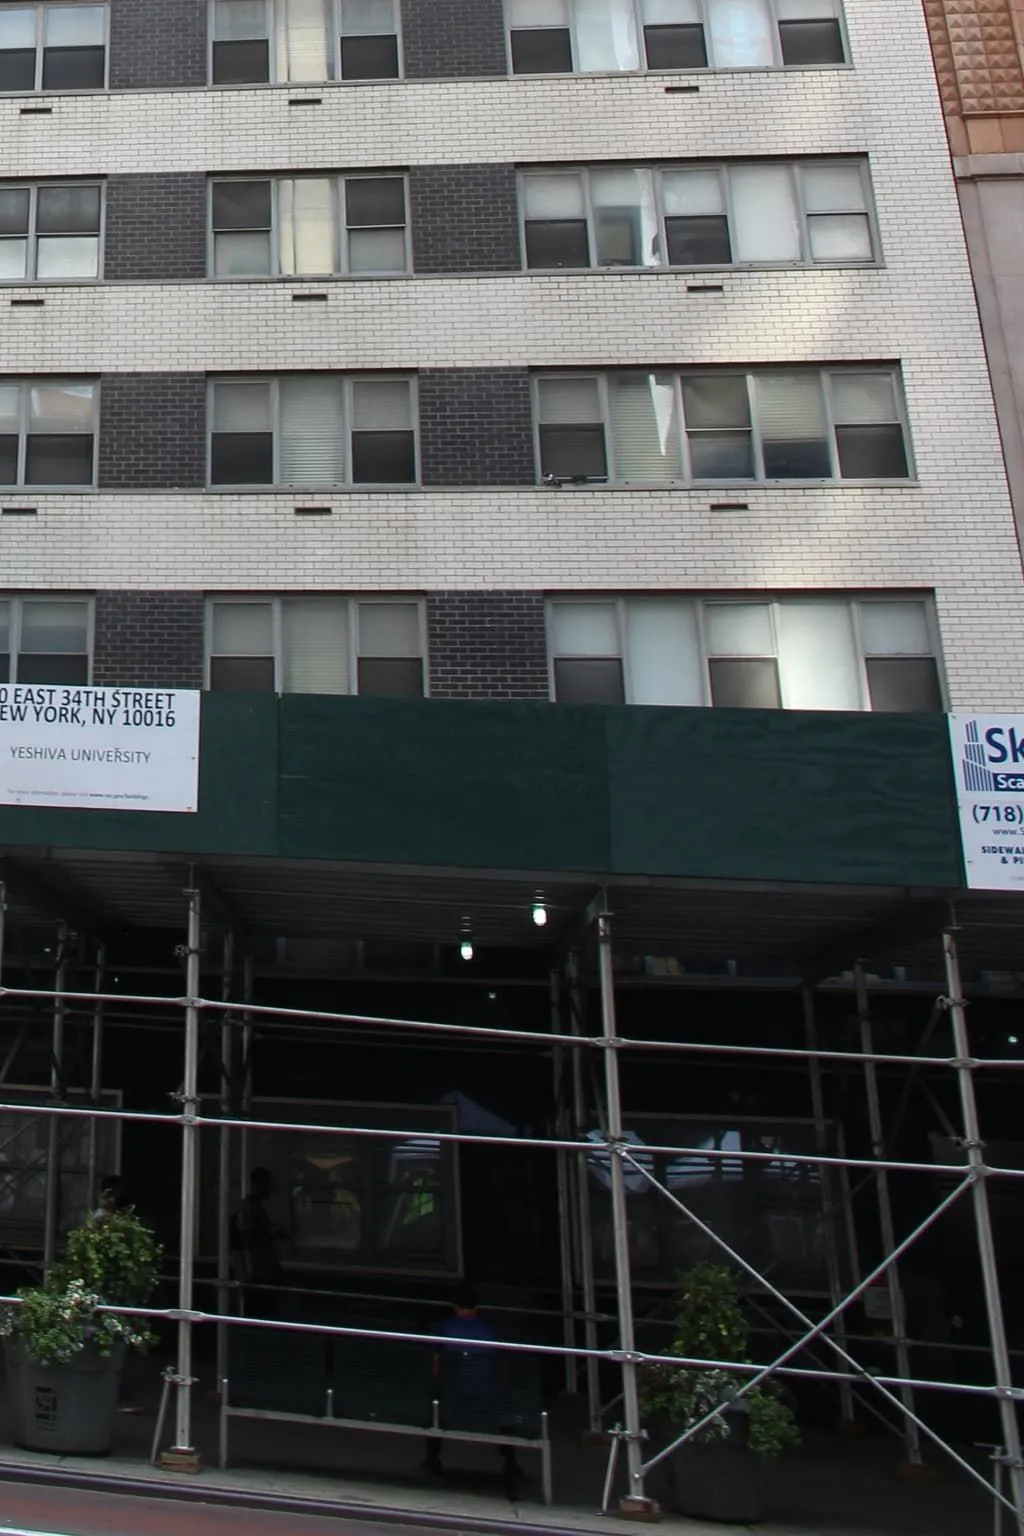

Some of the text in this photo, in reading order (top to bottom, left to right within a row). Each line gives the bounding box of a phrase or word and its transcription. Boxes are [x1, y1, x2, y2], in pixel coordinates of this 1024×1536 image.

[14, 688, 57, 706] EAST
[61, 690, 106, 708] 34TH
[112, 692, 176, 710] STREET
[33, 705, 86, 727] YORK,
[92, 709, 117, 725] NY
[123, 709, 176, 727] 10016
[10, 746, 152, 764] YESHIVA UNIVERSITY
[972, 804, 1024, 825] (718)
